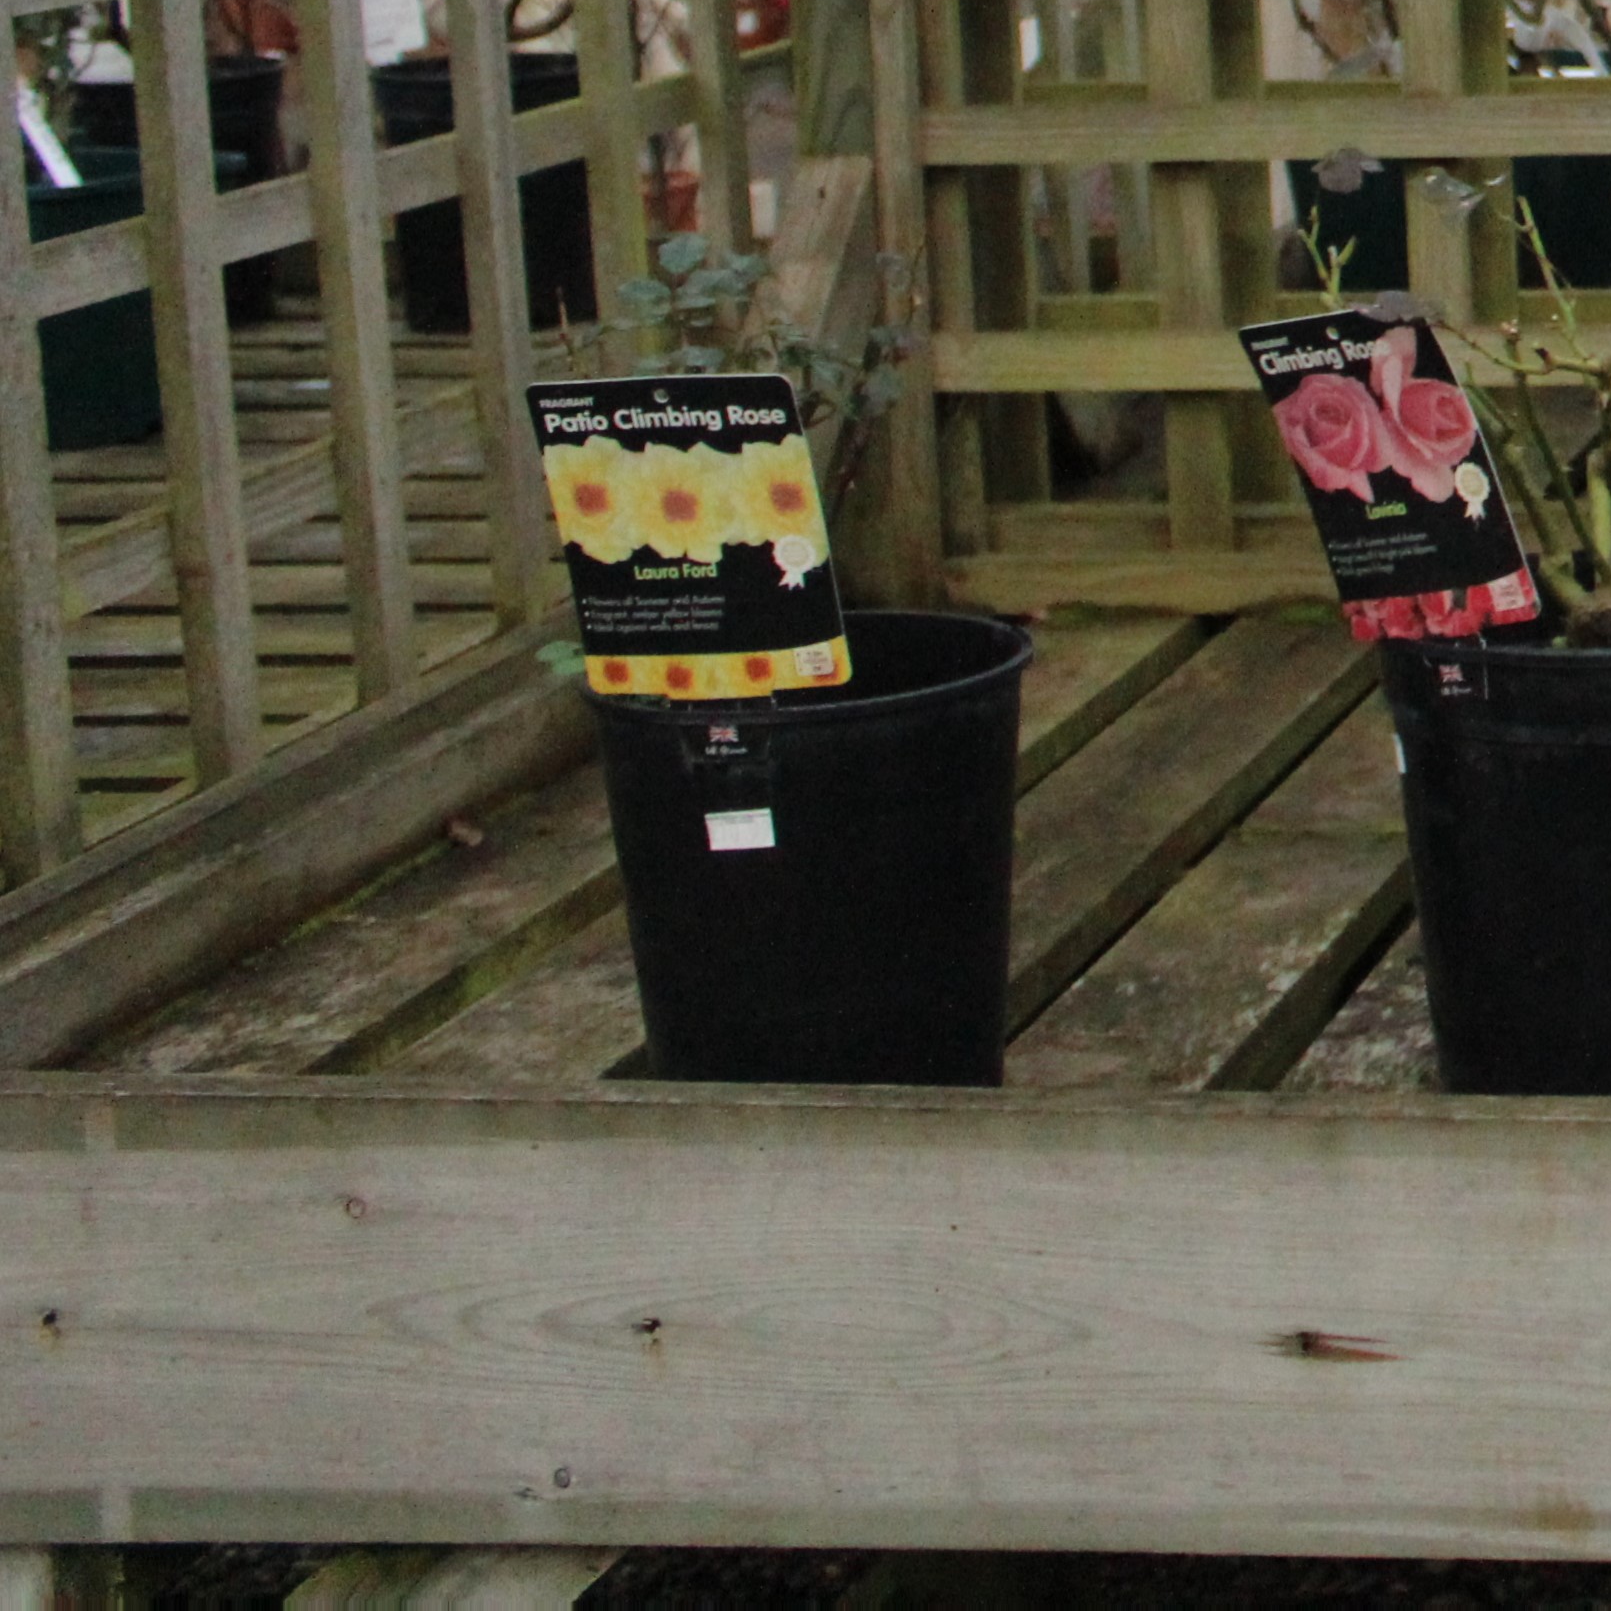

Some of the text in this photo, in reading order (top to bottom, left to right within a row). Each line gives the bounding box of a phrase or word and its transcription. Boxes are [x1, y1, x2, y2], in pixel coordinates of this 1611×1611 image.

[1259, 340, 1391, 375] Climbing Rose
[543, 405, 787, 433] Patio Climbing Rose
[633, 562, 718, 580] Laura Ford
